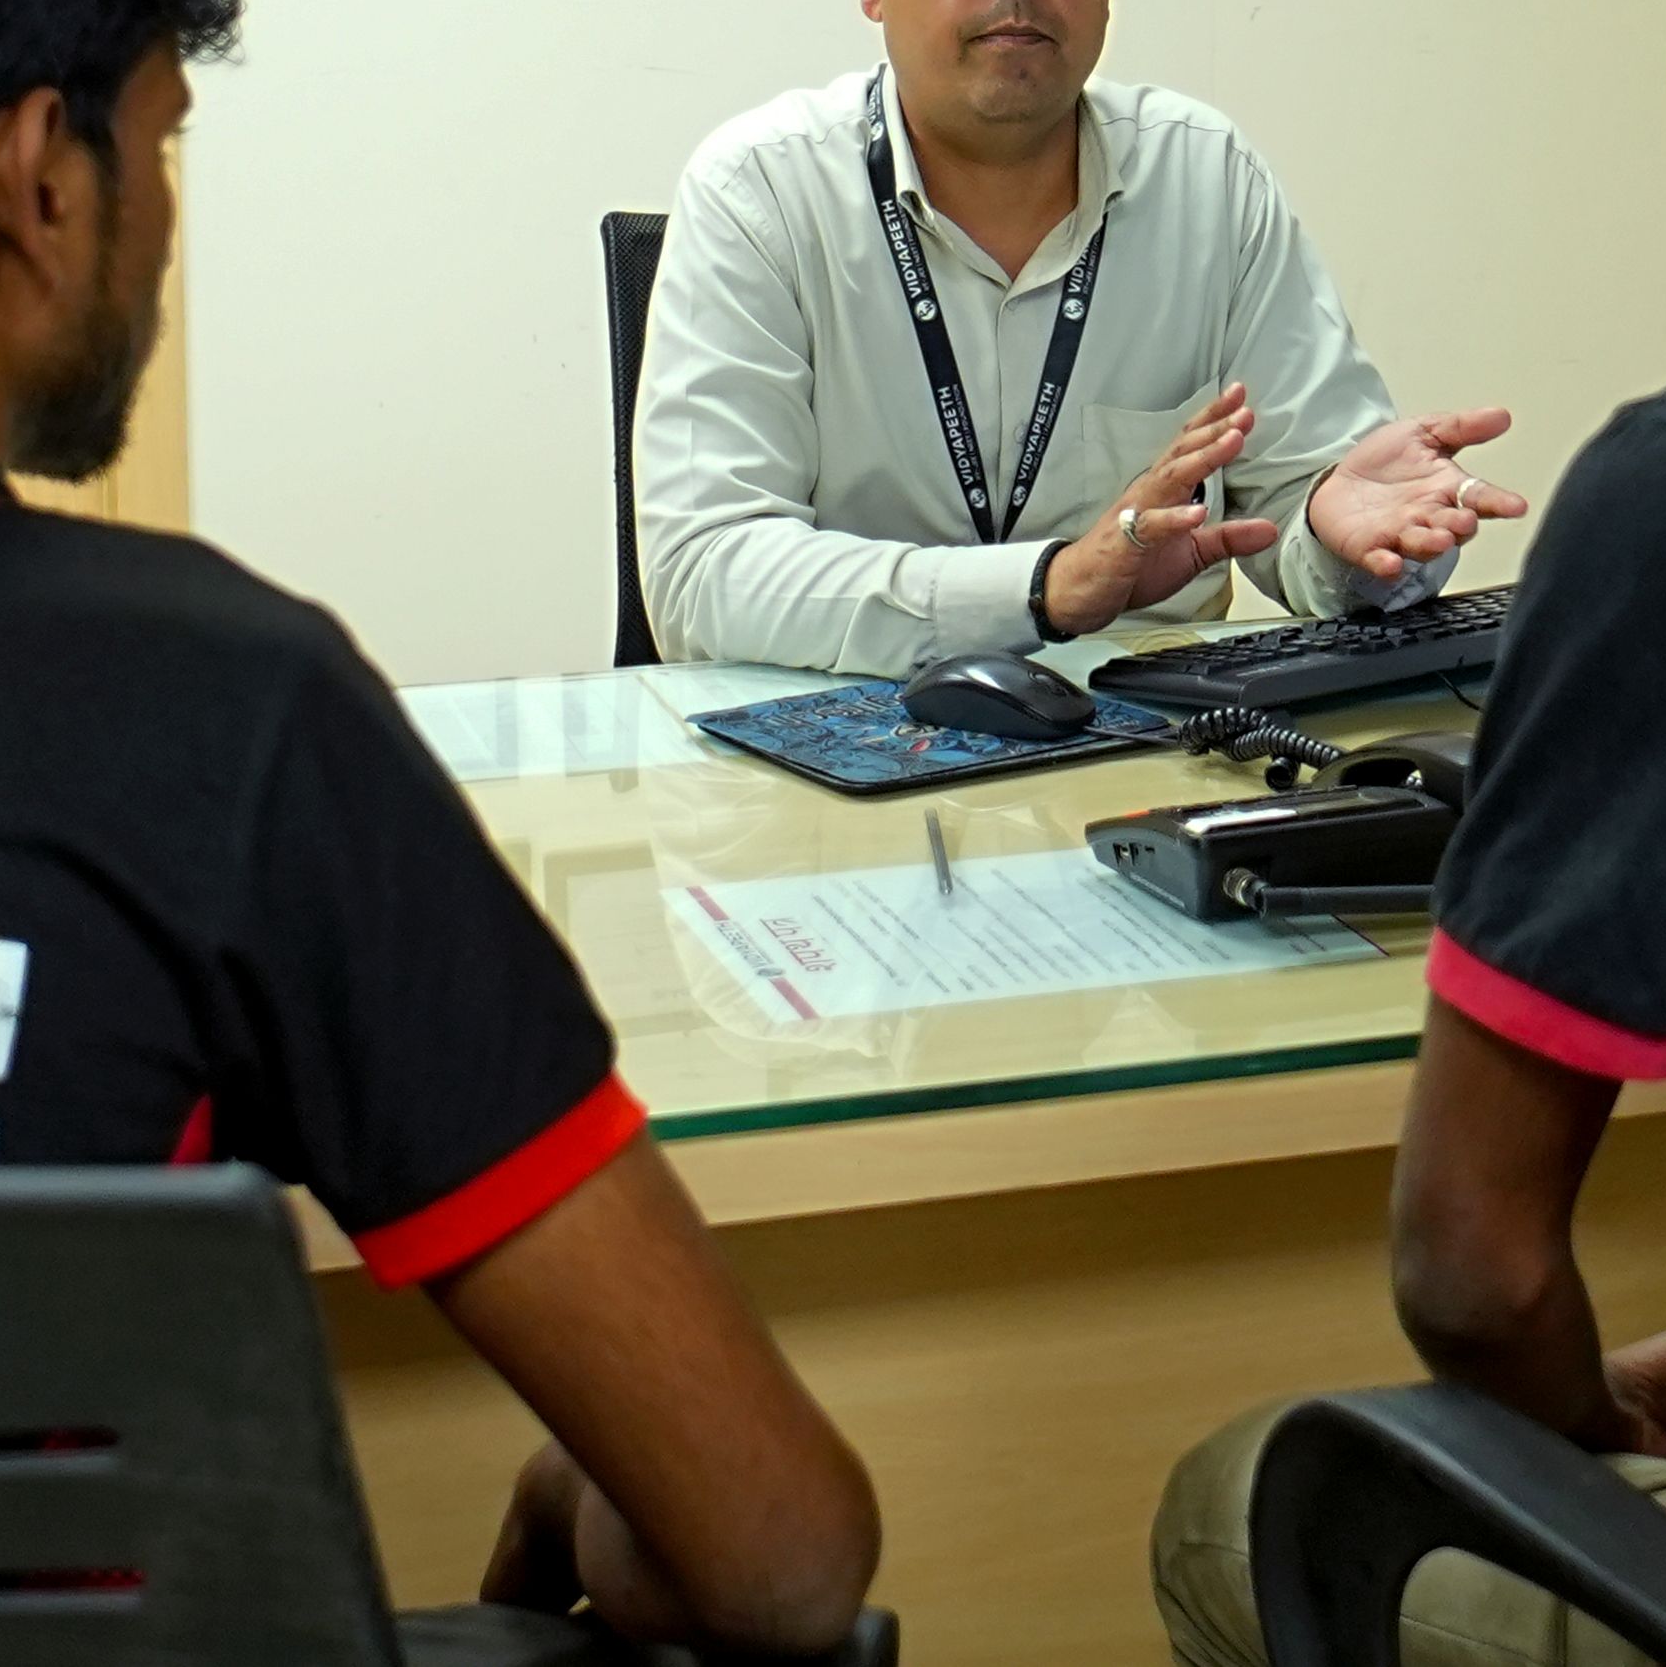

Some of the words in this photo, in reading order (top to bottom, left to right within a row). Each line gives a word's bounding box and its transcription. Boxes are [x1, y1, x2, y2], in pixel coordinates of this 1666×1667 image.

[881, 199, 922, 298] VIDYAPEETH
[938, 385, 974, 485] VIDYAPEETH
[1018, 381, 1055, 481] VIDYAPEETH
